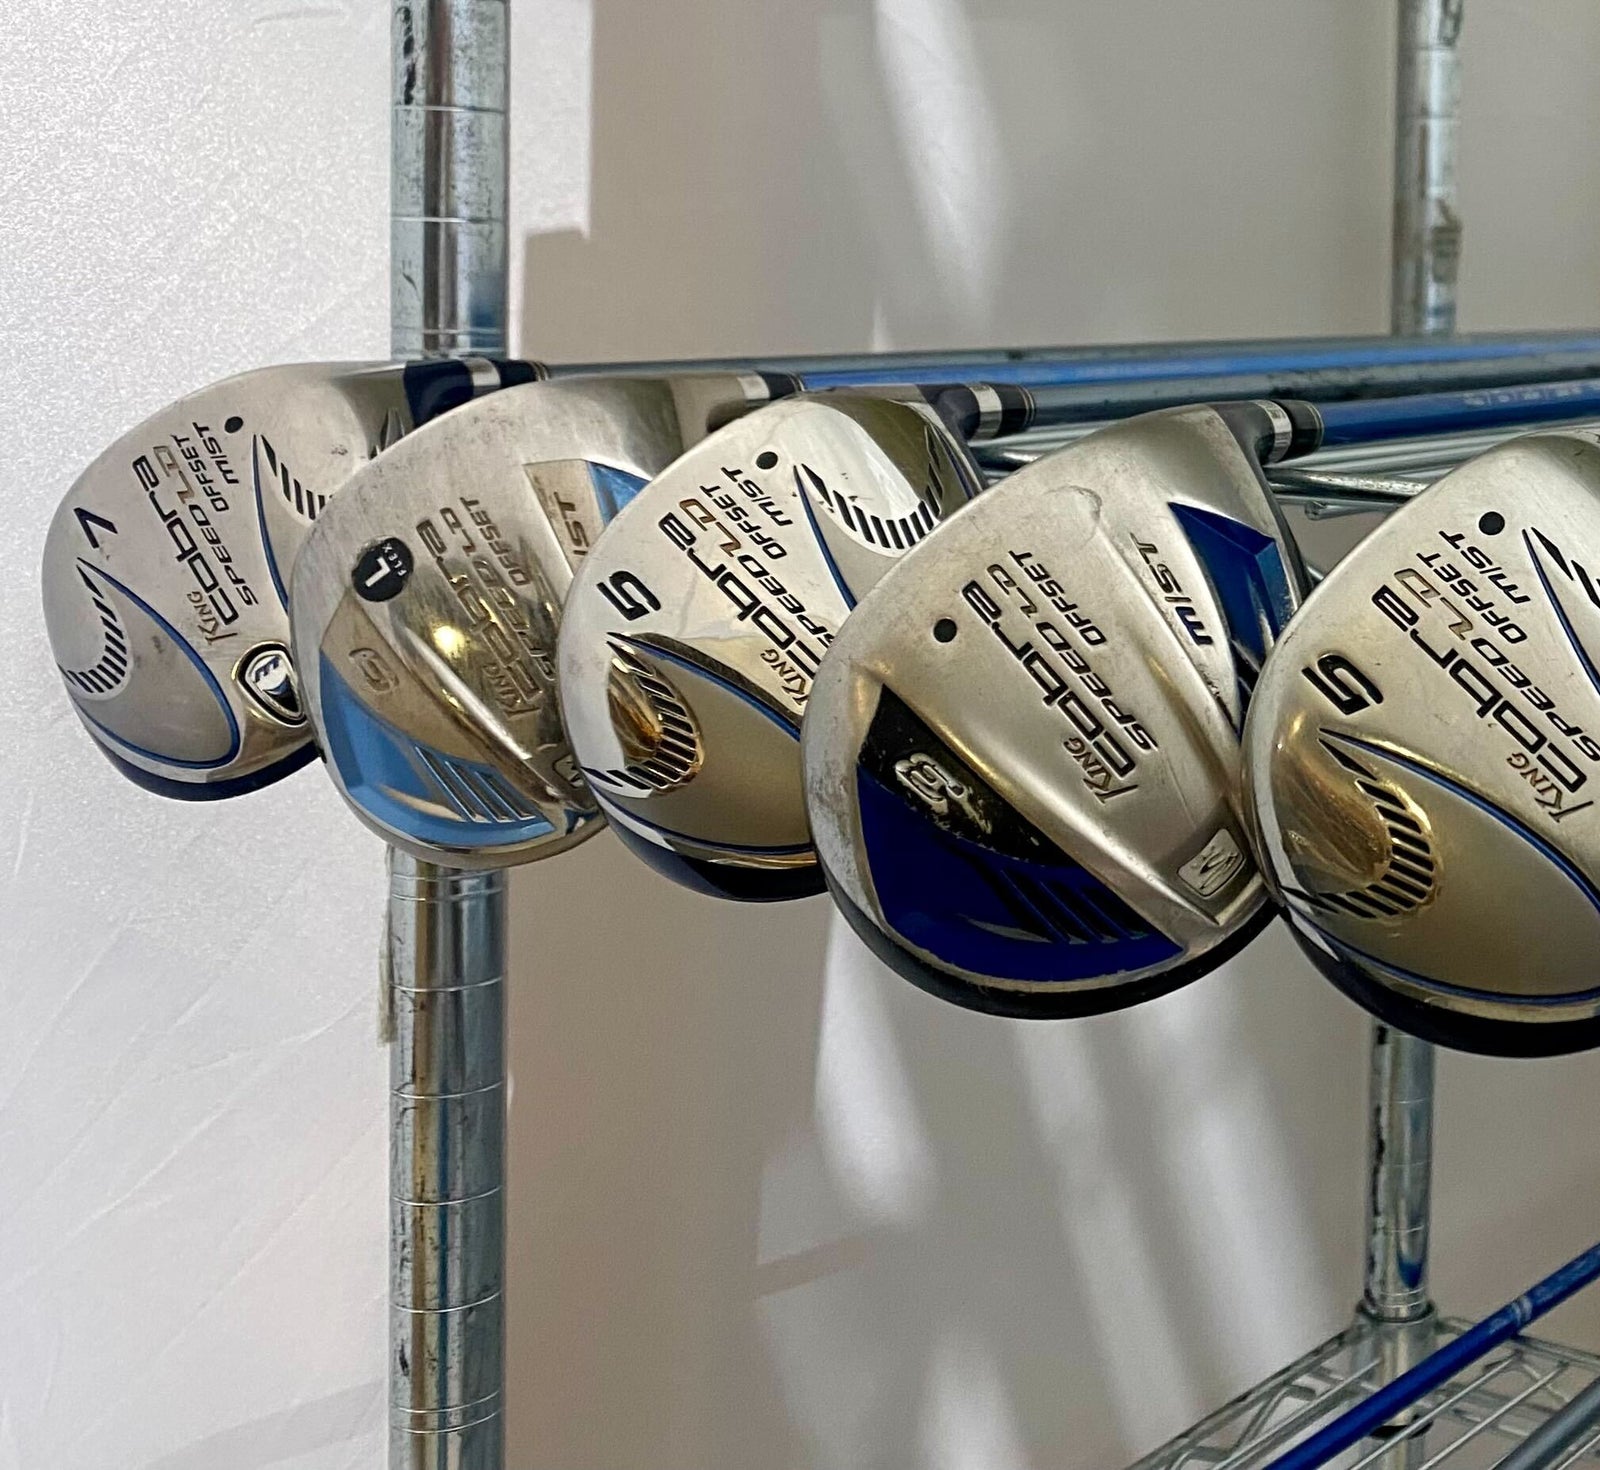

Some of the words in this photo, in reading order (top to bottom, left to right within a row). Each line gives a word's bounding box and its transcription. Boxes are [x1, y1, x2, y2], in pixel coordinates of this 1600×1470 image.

[170, 433, 230, 513] OFFSET
[73, 506, 119, 549] 7
[132, 455, 240, 627] cobra
[188, 504, 260, 607] SPEED
[381, 542, 408, 577] FLEX
[459, 496, 531, 587] OFFSET
[699, 483, 788, 561] OFFSET
[365, 556, 391, 588] L
[415, 518, 545, 702] cobra
[596, 569, 662, 622] 5
[658, 511, 827, 680] cobra
[1007, 549, 1107, 647] OFFSET
[1416, 551, 1529, 645] OFFSET
[186, 590, 239, 646] KING
[471, 557, 556, 682] SPEED
[961, 579, 1139, 778] cobra
[1035, 620, 1159, 752] SPEED
[1301, 652, 1386, 716] 5
[1372, 584, 1589, 793] cobra
[894, 751, 969, 803] 3
[1061, 736, 1139, 806] KING
[1506, 750, 1595, 824] KING
